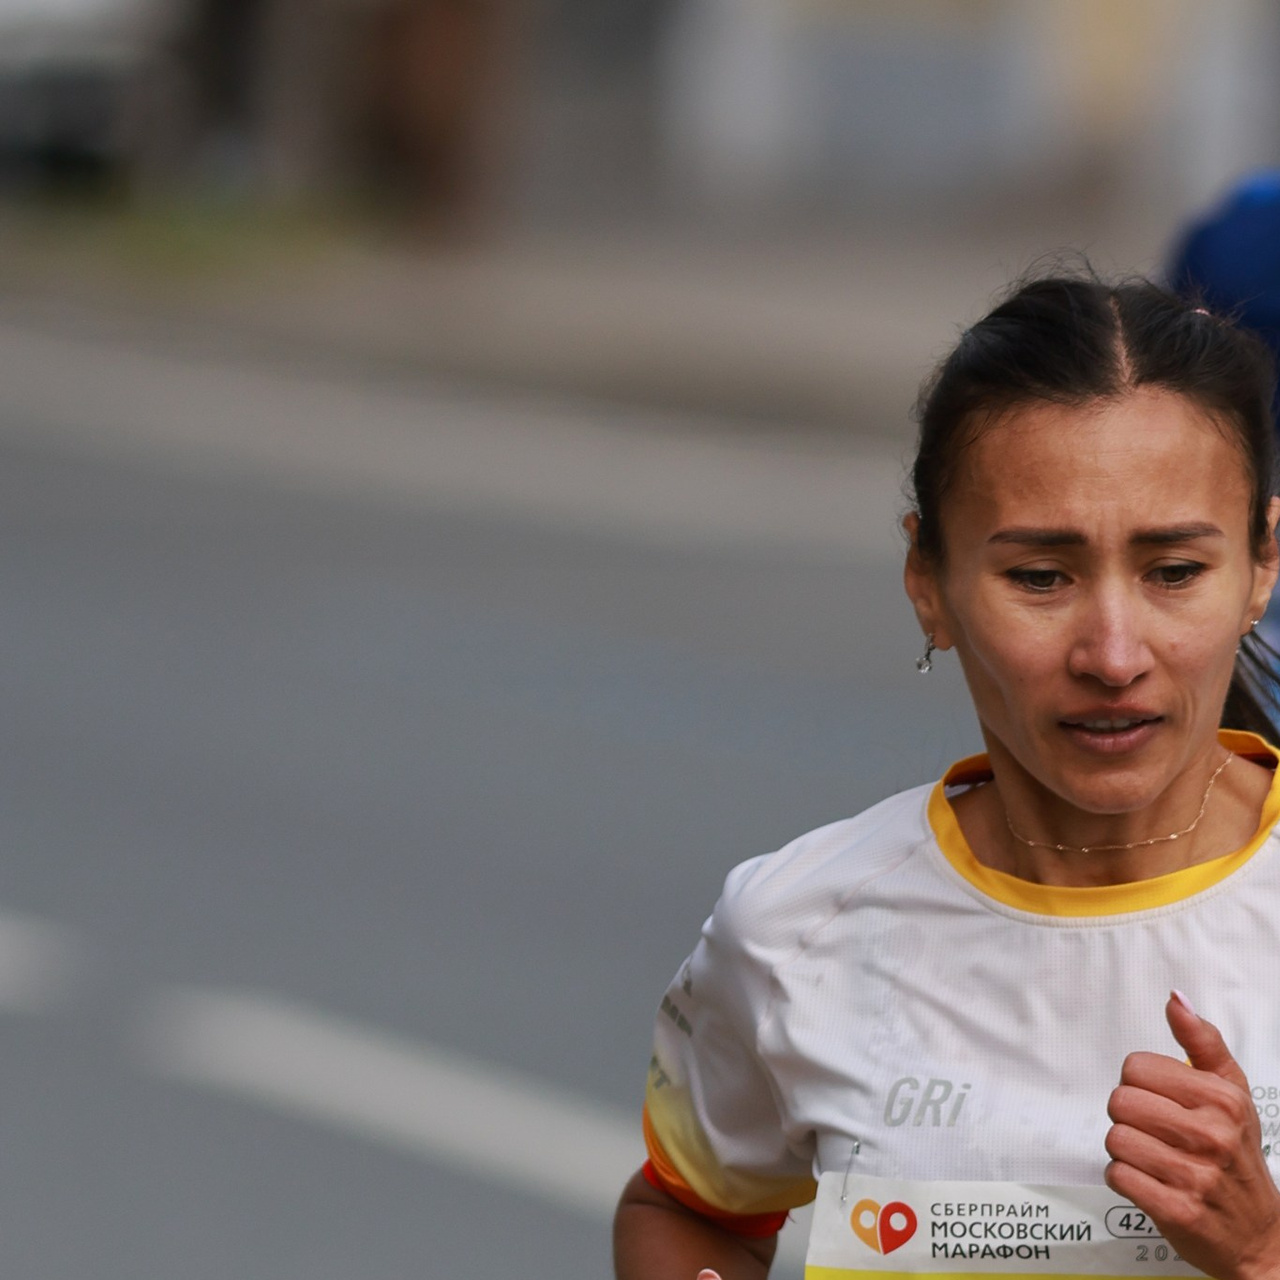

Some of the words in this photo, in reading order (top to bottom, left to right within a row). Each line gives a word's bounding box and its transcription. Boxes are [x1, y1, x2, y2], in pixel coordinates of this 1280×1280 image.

[883, 1077, 972, 1127] GRi
[930, 1201, 1050, 1218] СБЕРПРАЙМ
[931, 1220, 1092, 1242] МОСКОВСКИЙ
[1118, 1213, 1154, 1233] 42,
[931, 1242, 1051, 1260] МАРАФОН
[1135, 1244, 1181, 1262] 20
